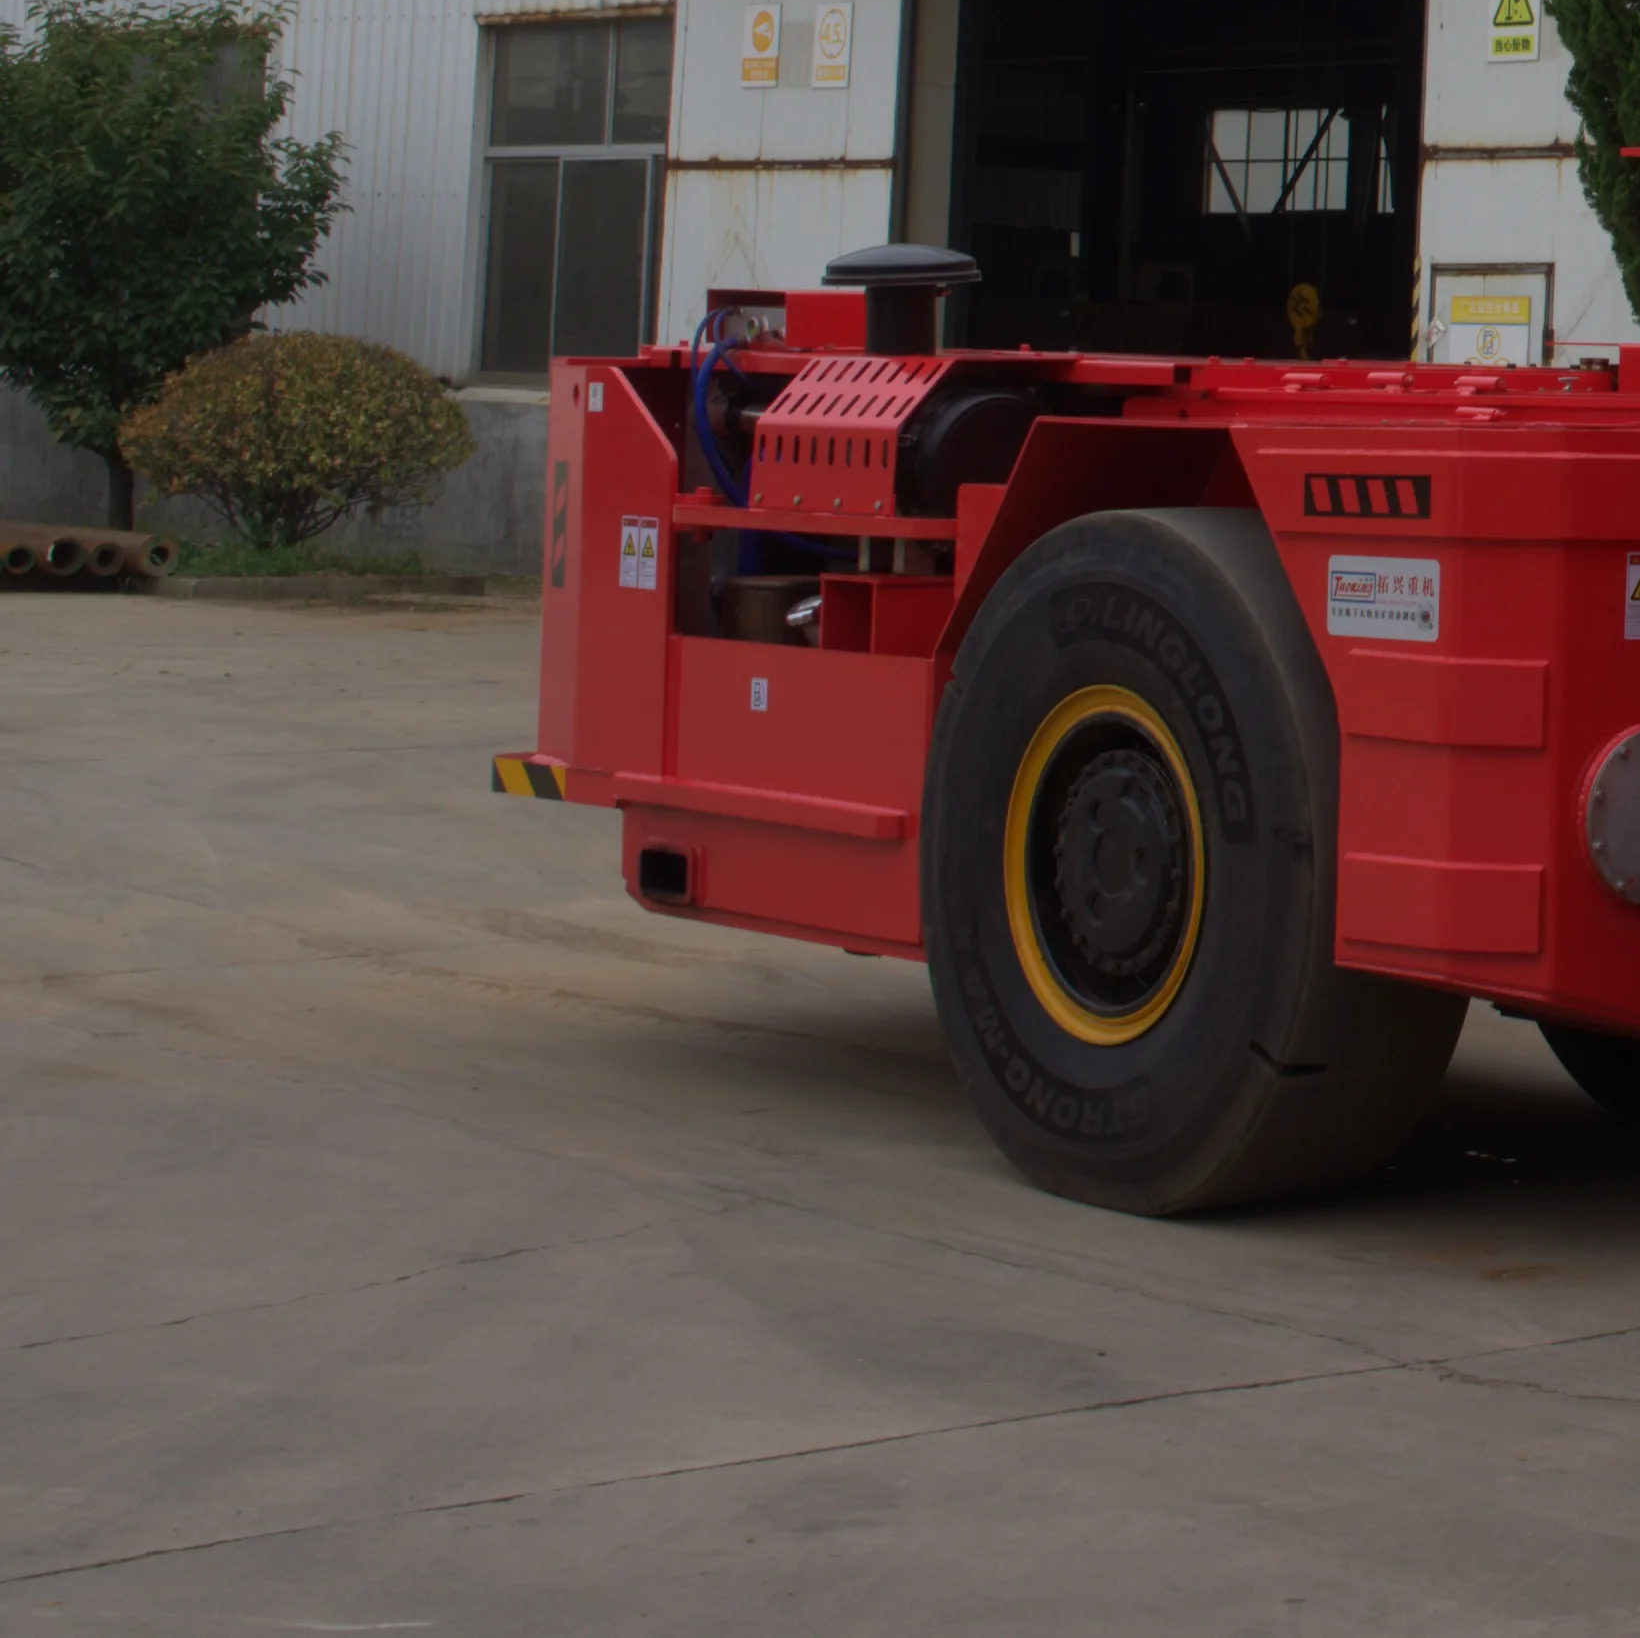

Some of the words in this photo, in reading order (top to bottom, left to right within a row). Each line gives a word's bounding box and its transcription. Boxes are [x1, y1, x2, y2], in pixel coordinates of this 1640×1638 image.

[1495, 36, 1532, 53] 当心坠物
[1377, 573, 1435, 597] 拓兴重机
[1101, 594, 1247, 822] LINGLONG
